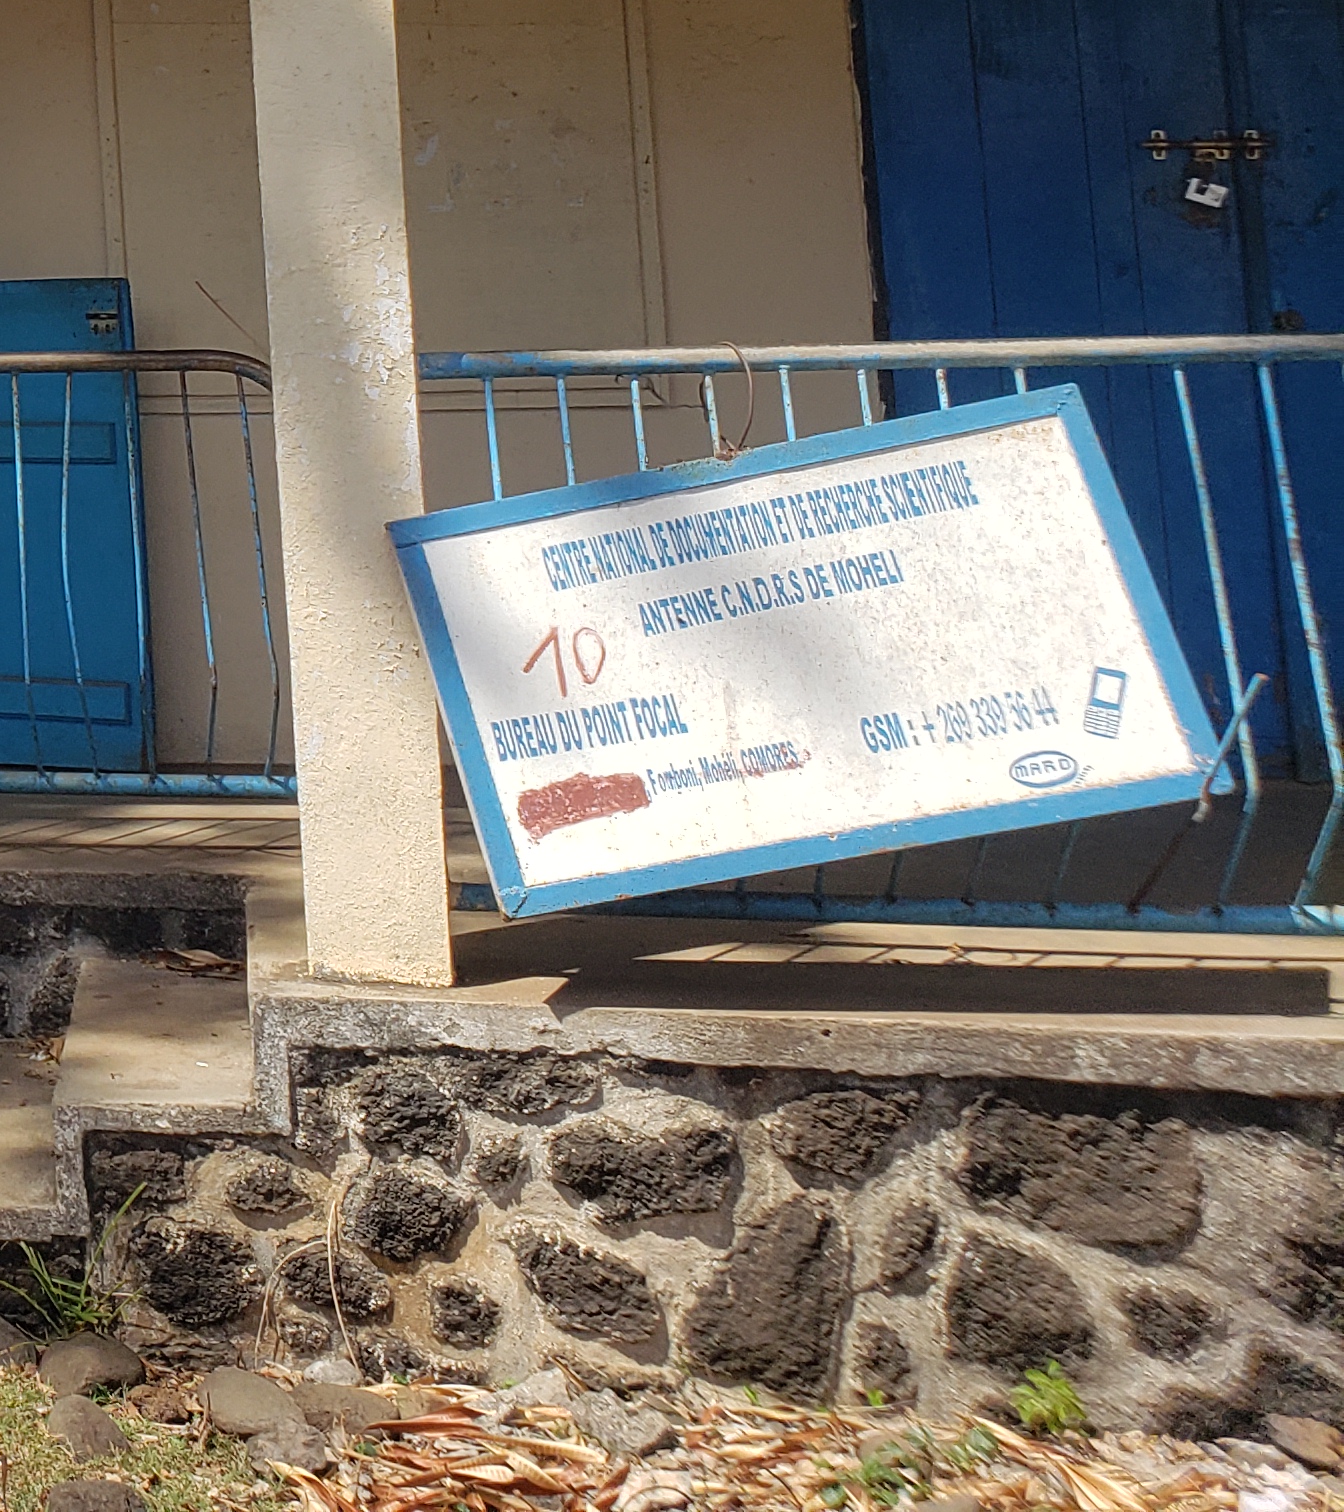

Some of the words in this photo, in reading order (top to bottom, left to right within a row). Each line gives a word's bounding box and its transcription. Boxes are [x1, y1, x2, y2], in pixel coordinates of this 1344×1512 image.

[541, 539, 599, 592] CENTRE
[588, 526, 658, 582] NATIONAL
[648, 521, 676, 569] DE
[666, 500, 779, 564] DOCUMENTATION
[770, 497, 795, 544] ET
[787, 493, 816, 540] DE
[806, 478, 890, 537] RECHERCHE
[880, 460, 980, 522] SCIENTIFIQUE
[637, 587, 724, 638] ANTENNE
[721, 569, 806, 618] C.N.D.R.S
[802, 563, 835, 600] DE
[829, 548, 905, 594] MOHELI
[522, 625, 606, 698] 10
[490, 713, 559, 762] BUREAU
[555, 709, 583, 752] DU
[579, 700, 634, 749] POINT
[629, 692, 689, 740] FOCAL
[861, 712, 910, 754] GSM
[936, 700, 974, 744] 269
[969, 693, 1009, 738] 339
[1003, 690, 1035, 732] 56
[739, 740, 800, 777] COMORES
